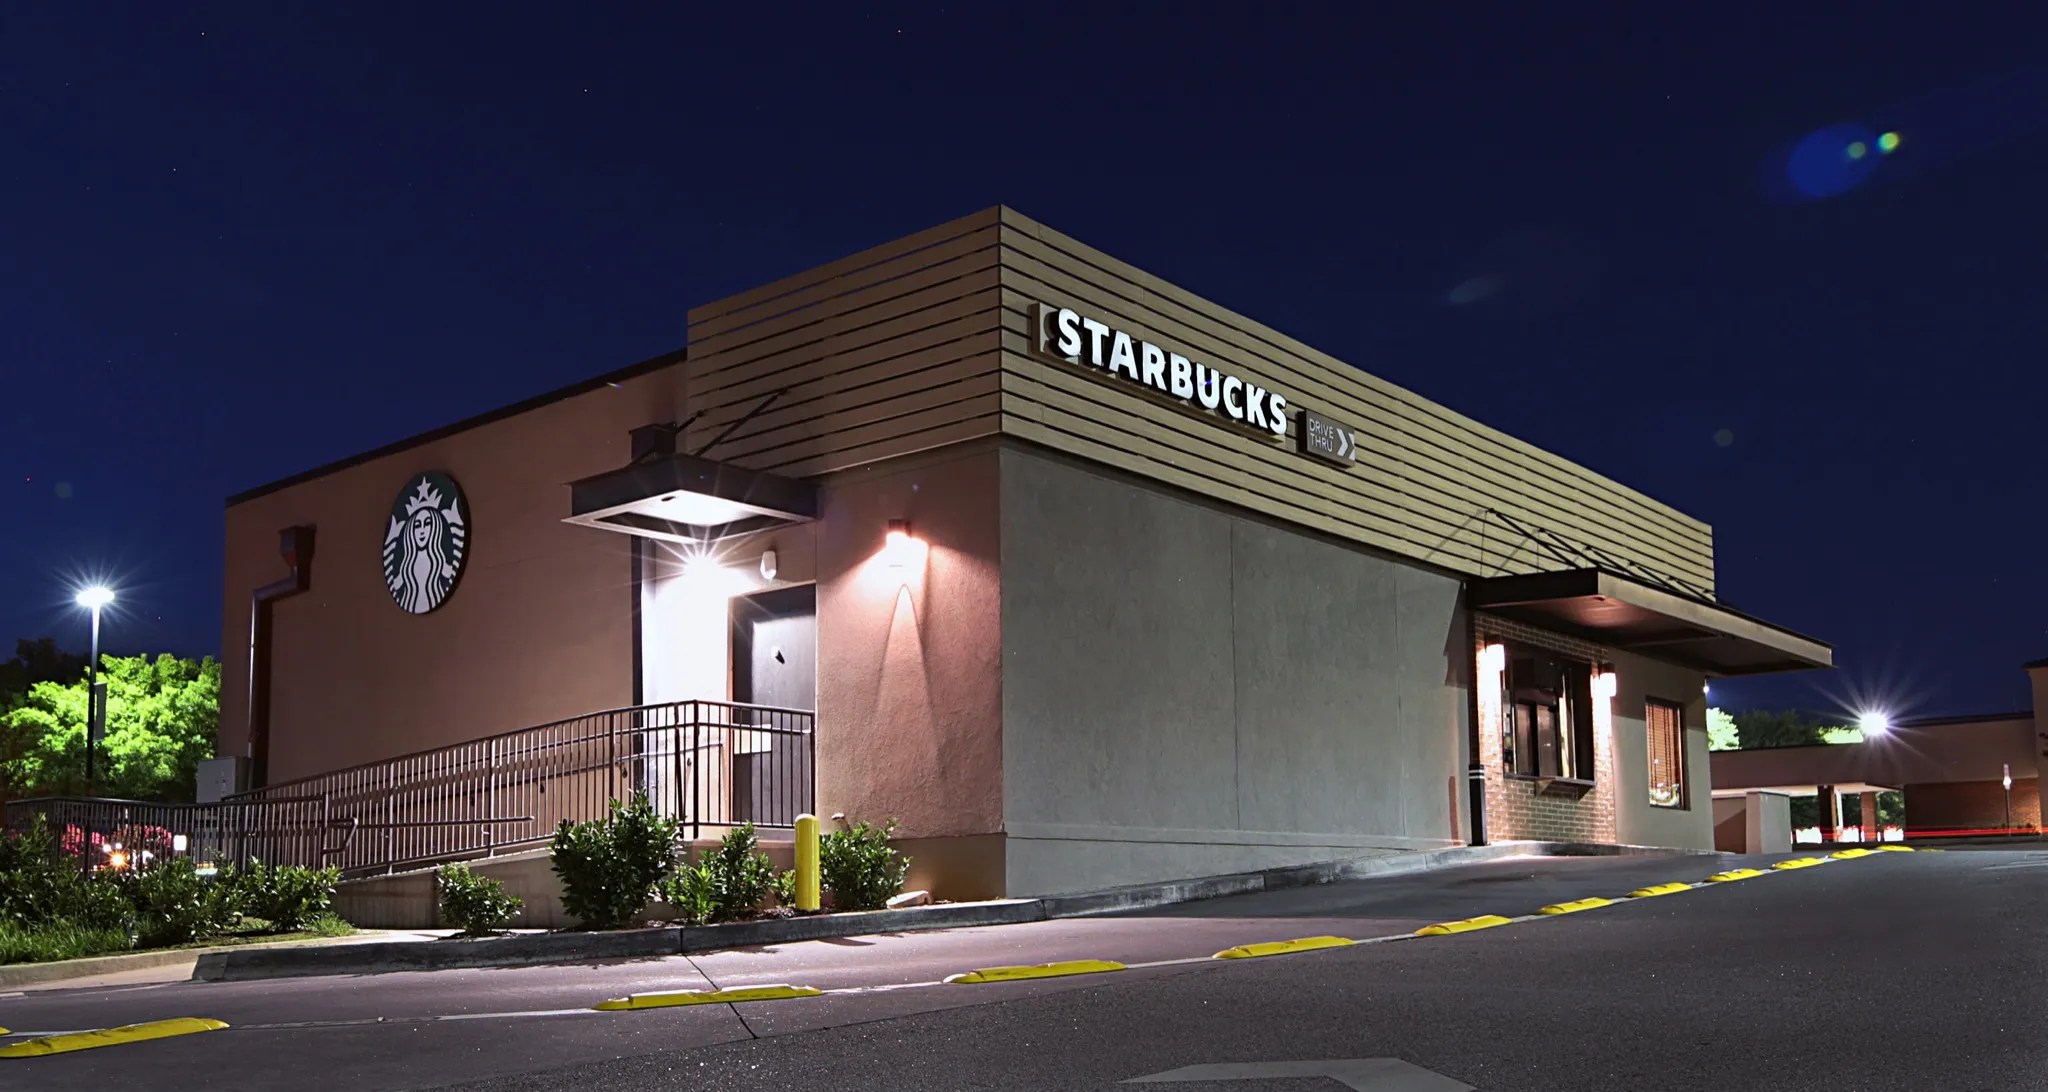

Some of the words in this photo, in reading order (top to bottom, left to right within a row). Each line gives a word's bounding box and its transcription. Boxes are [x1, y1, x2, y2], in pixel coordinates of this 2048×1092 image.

[1058, 308, 1287, 435] STARBUCKS
[1309, 418, 1334, 439] DRIVE
[1310, 433, 1333, 452] THRU
